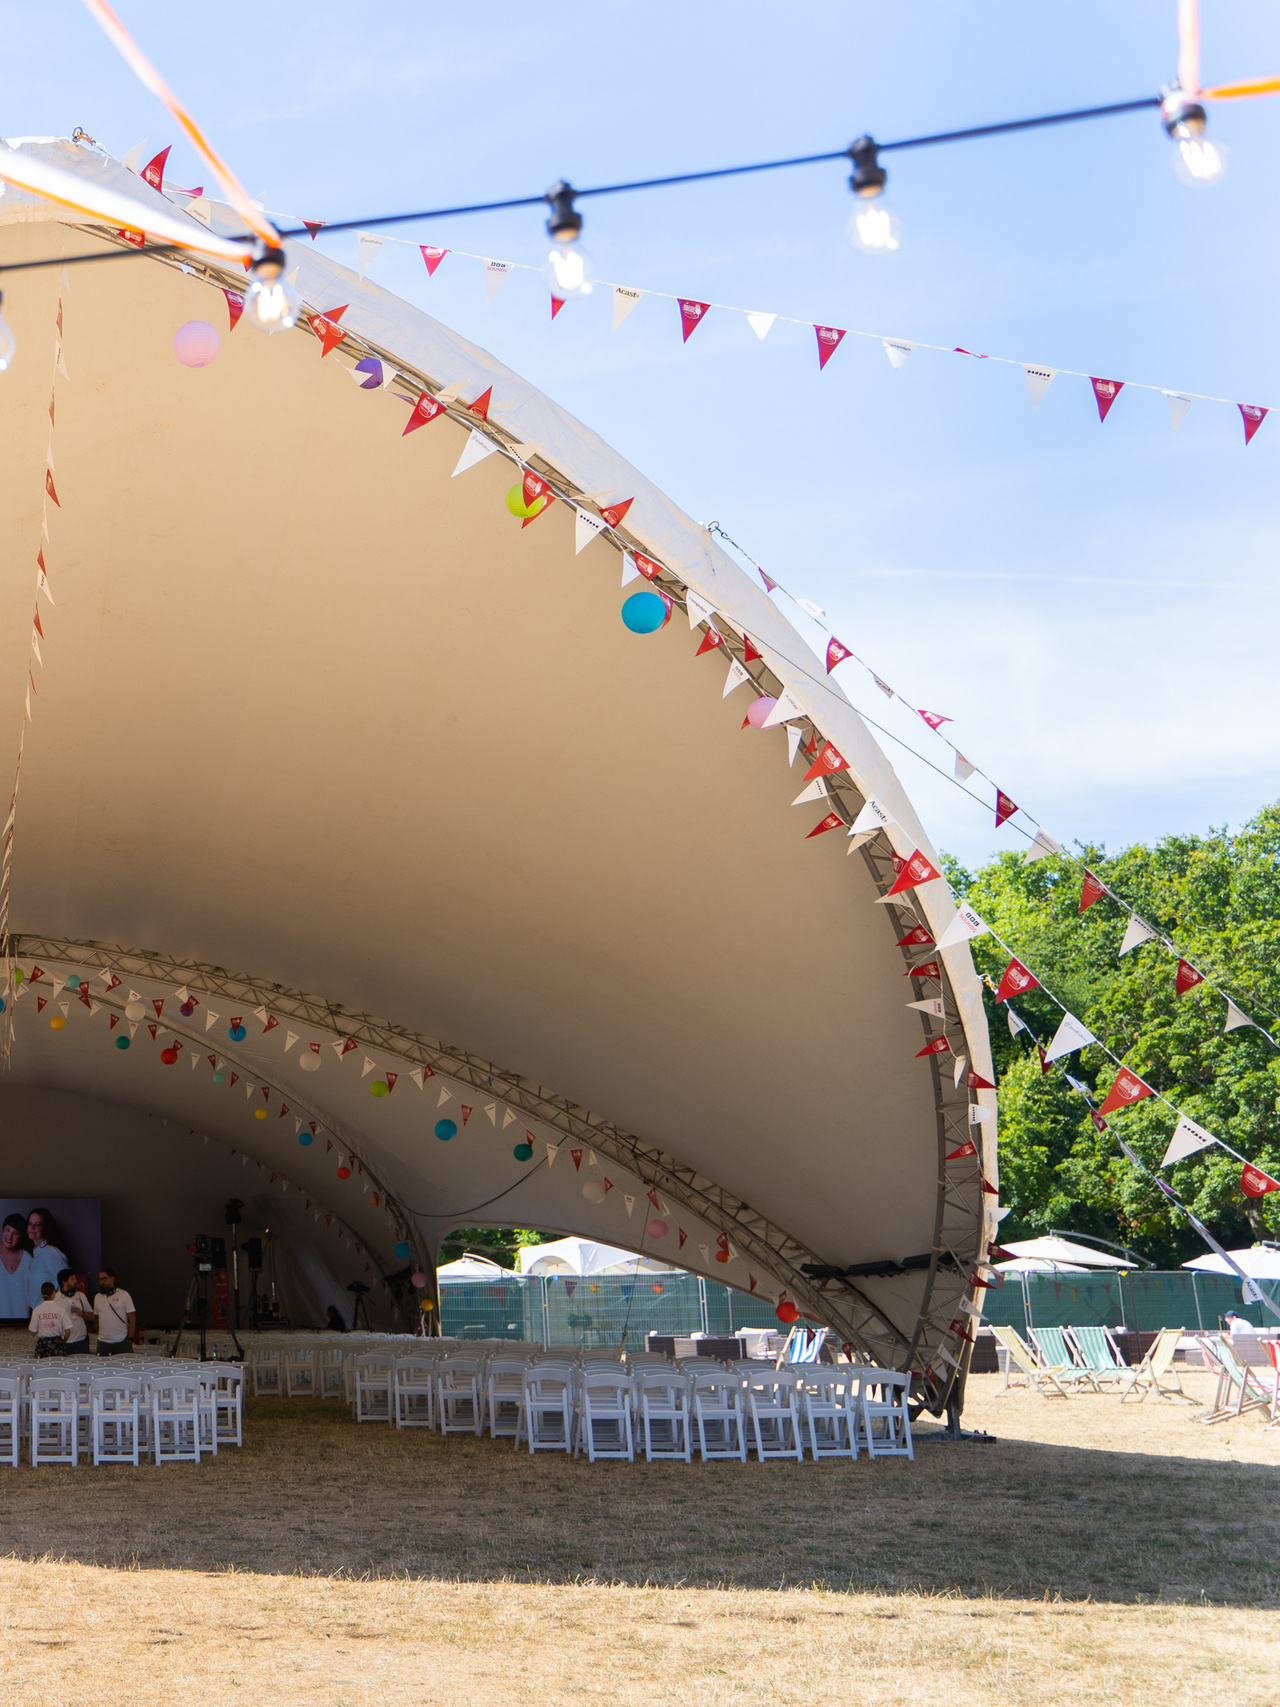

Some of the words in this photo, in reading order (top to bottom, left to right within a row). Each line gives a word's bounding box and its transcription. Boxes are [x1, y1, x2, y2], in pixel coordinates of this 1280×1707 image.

[1027, 370, 1051, 378] podpod
[579, 514, 599, 528] podpod
[869, 800, 889, 823] Acast+
[959, 913, 977, 933] SOUNDS
[965, 912, 980, 927] BBC
[1182, 1124, 1207, 1142] podpod
[38, 1312, 59, 1320] CREW
